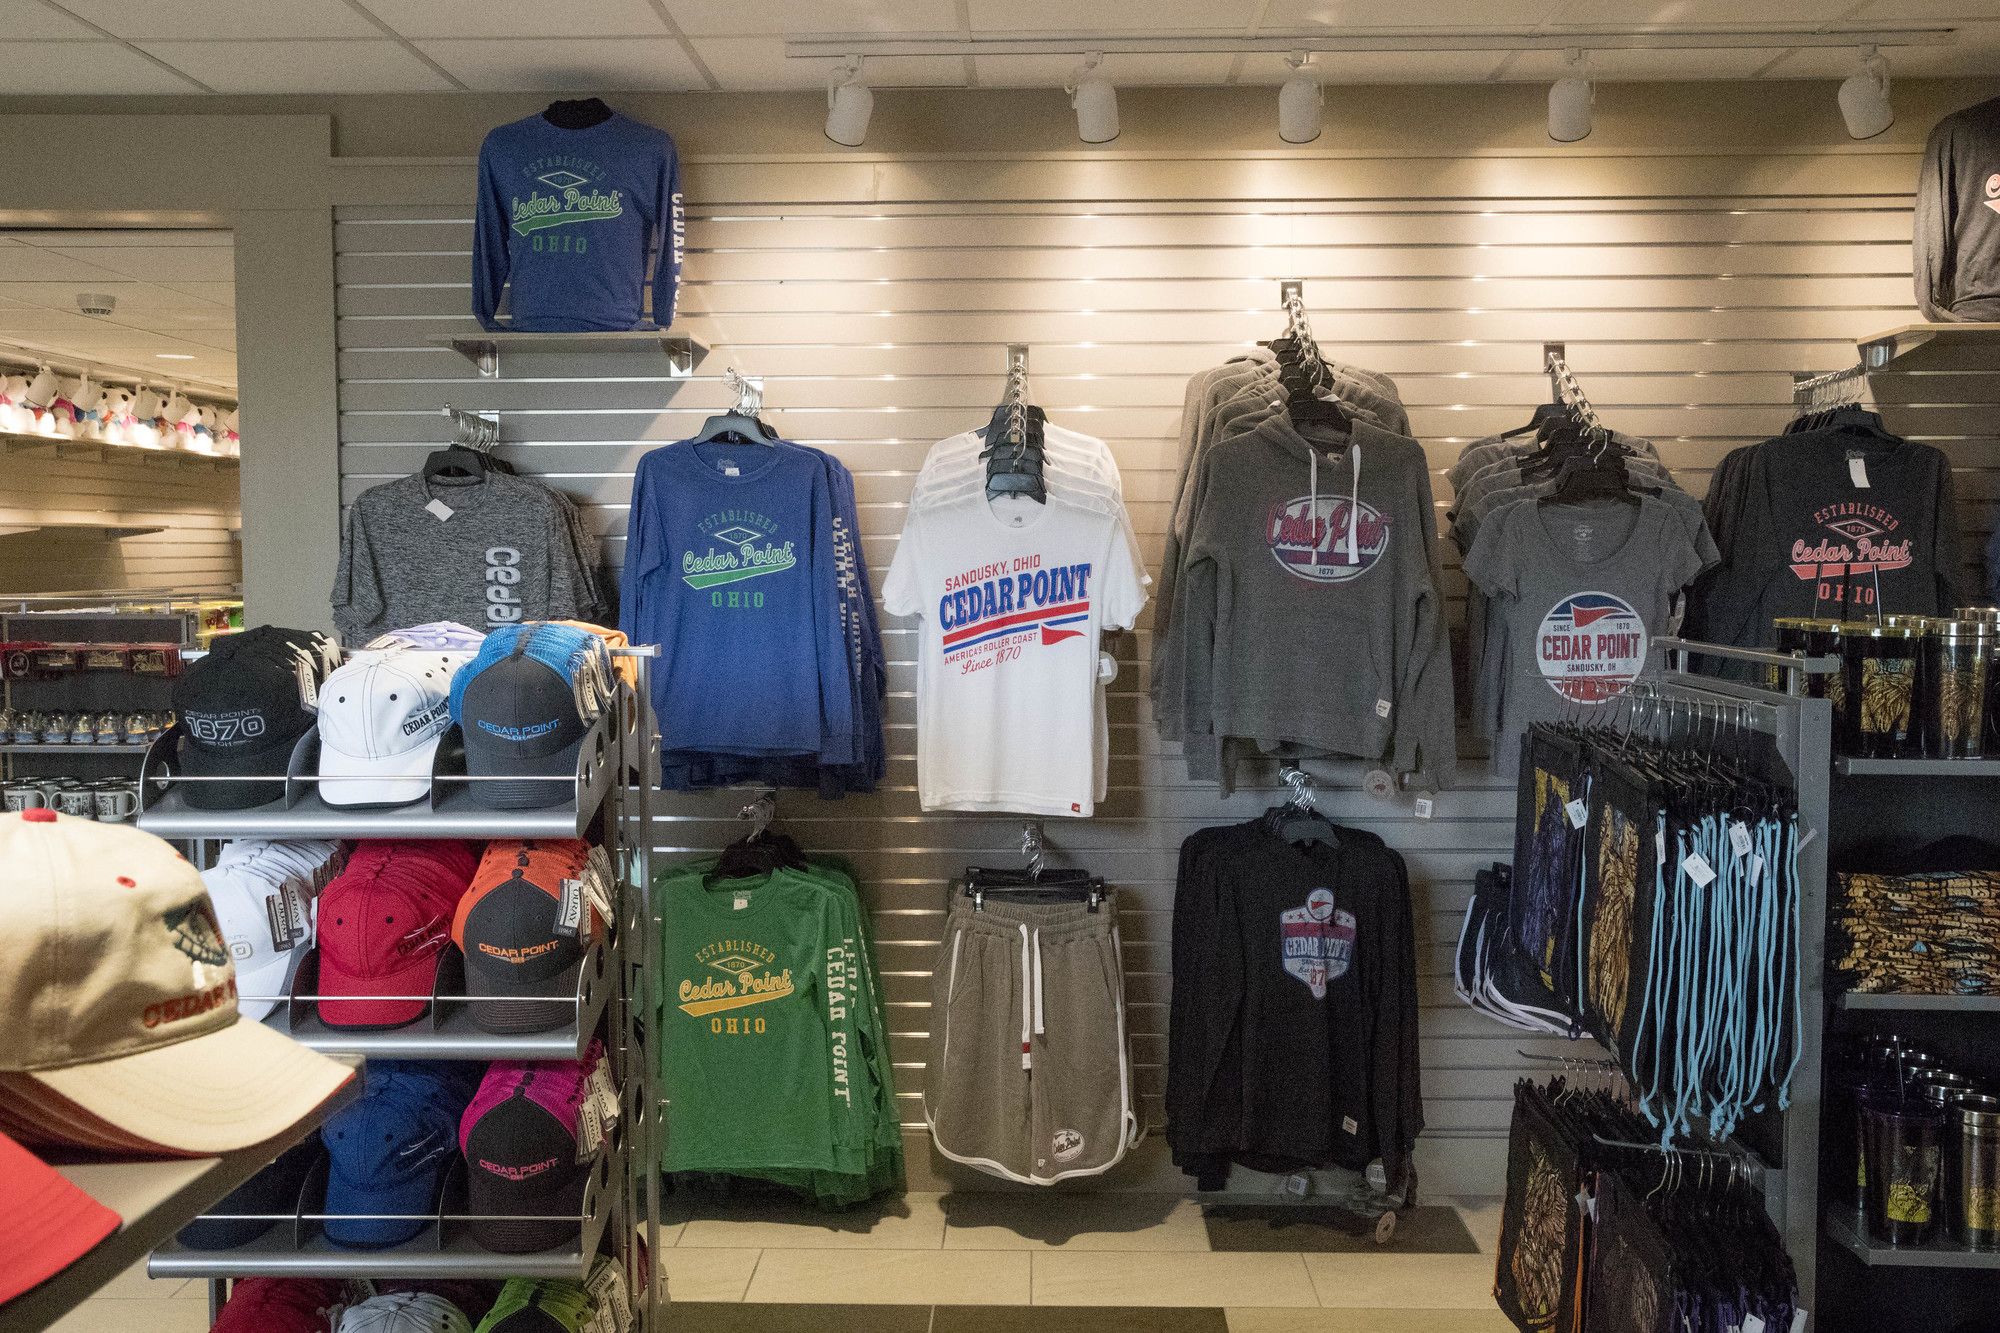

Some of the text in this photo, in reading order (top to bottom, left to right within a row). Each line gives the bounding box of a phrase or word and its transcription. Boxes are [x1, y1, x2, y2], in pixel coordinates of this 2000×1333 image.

[564, 188, 620, 211] Point
[532, 235, 588, 254] OHIO
[698, 509, 778, 534] ESTABLISHED
[1814, 502, 1899, 532] ESTABLISHED
[1846, 526, 1866, 534] 1870
[683, 541, 793, 574] Cedar Point
[1792, 538, 1910, 563] Cedar Point
[945, 554, 1041, 592] SANDUSKY, OHIO
[711, 591, 764, 608] OHIO
[939, 563, 1092, 631] CEDAR POINT
[1553, 622, 1630, 633] SINCE 1870
[944, 632, 1038, 666] AMERICA'S ROLLER COAST
[1542, 633, 1640, 662] CEDAR POINT
[961, 646, 1021, 675] Since 1870
[1607, 662, 1616, 672] OH
[186, 708, 257, 720] CEDAR POINT
[402, 695, 450, 736] CEDAR POIN
[185, 715, 265, 740] 1870
[478, 719, 559, 736] CEDAR POINT
[570, 888, 580, 924] OURAY
[479, 940, 559, 958] CEDAR POINT
[695, 940, 776, 965] ESTABLISHED
[1285, 936, 1318, 957] CEDAR
[679, 970, 790, 1002] Cedar Point
[827, 947, 846, 1021] CEDAR
[144, 985, 225, 1028] CEDAR
[711, 1018, 767, 1034] OHIO
[480, 1158, 558, 1176] CEDAR POINT
